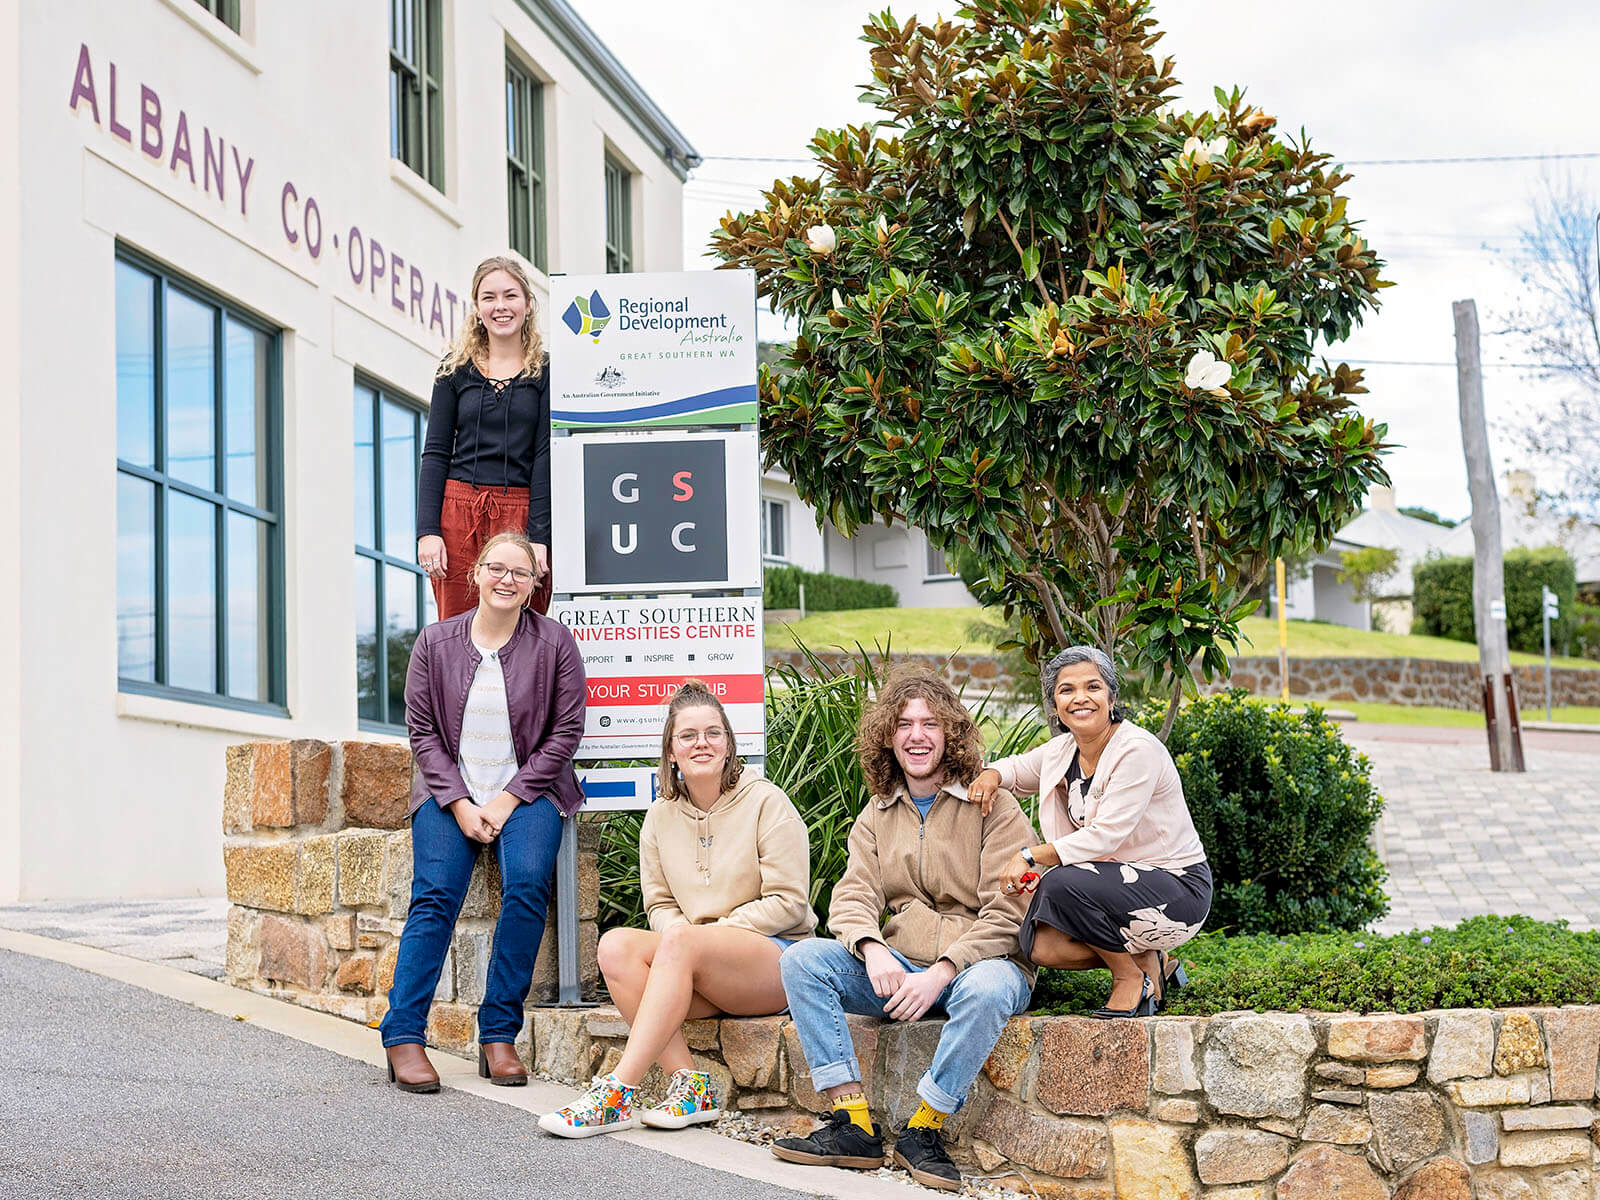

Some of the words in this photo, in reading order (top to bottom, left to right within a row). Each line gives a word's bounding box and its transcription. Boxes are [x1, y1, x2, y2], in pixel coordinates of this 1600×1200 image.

[69, 42, 254, 216] ALBANY
[619, 297, 688, 317] Regional
[619, 313, 727, 333] Development
[680, 324, 744, 346] Australia
[619, 353, 652, 361] GREAT
[659, 351, 713, 359] SOUTHERN
[719, 350, 736, 358] WA
[612, 473, 640, 503] G
[672, 471, 694, 502] S
[611, 523, 638, 555] U
[671, 522, 697, 553] C
[558, 609, 630, 626] GREAT
[639, 606, 756, 625] SOUTHERN
[572, 625, 680, 641] NIVERSITIES
[686, 624, 755, 639] CENTRE
[581, 655, 614, 664] UPPORT
[644, 654, 674, 662] INSPIRE
[707, 653, 734, 661] GROW
[587, 684, 630, 699] YOUR
[638, 683, 683, 698] STUD
